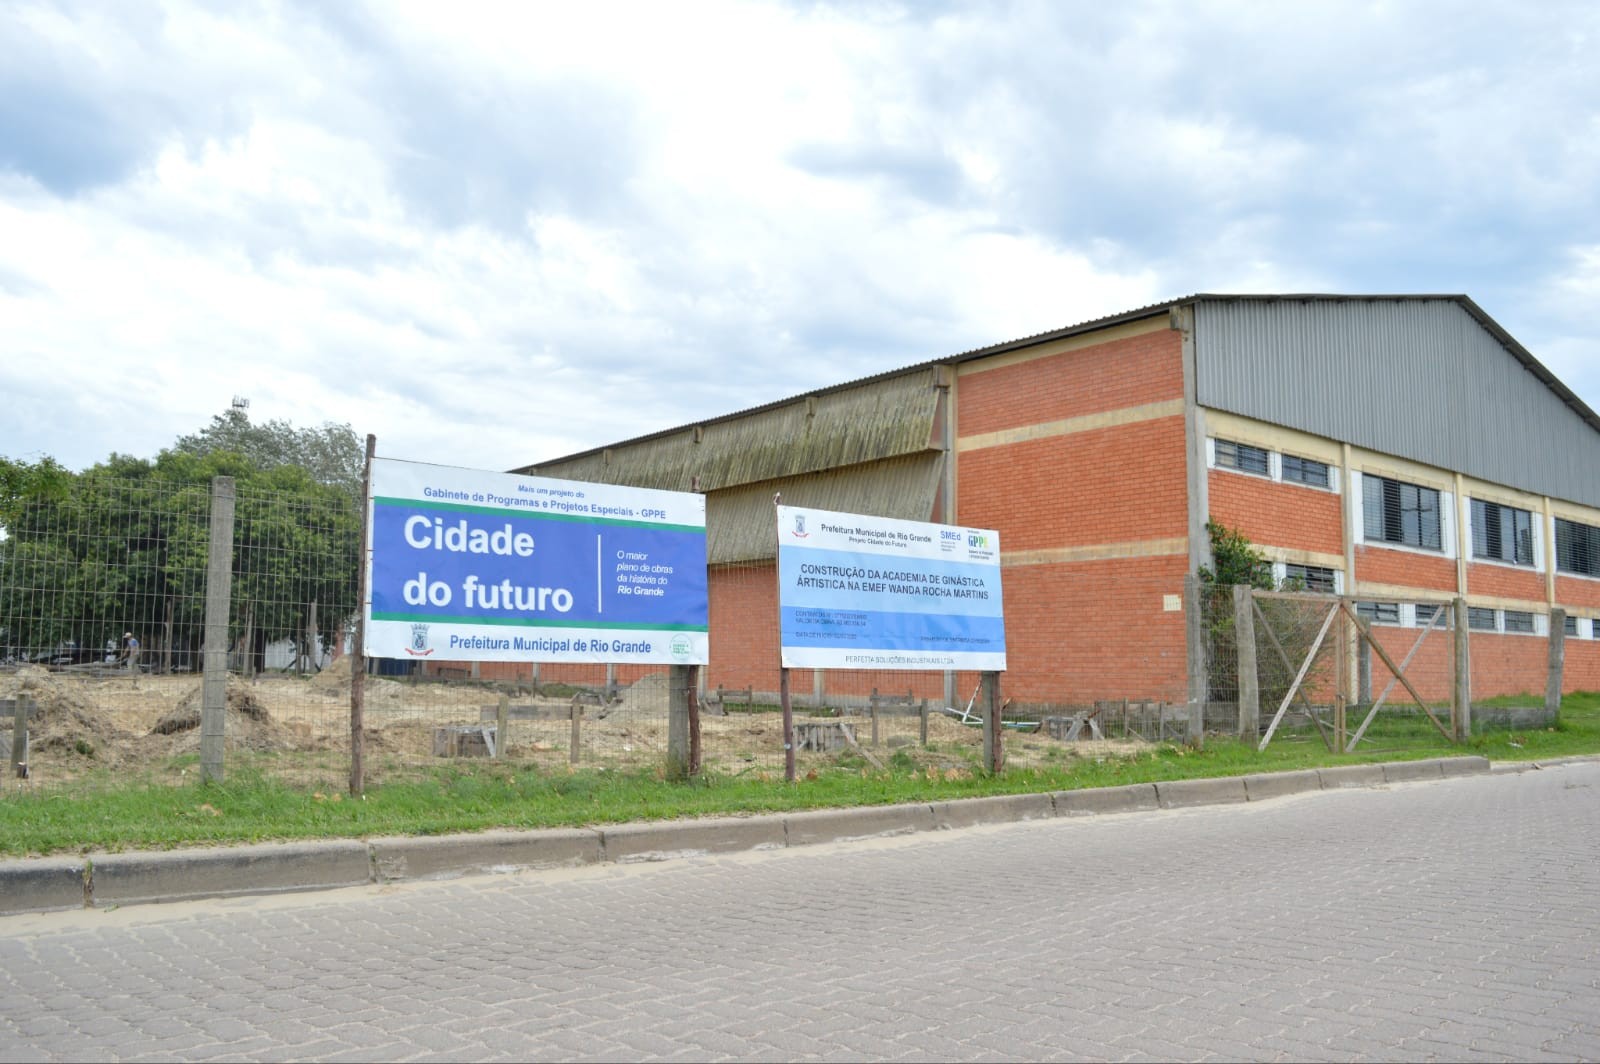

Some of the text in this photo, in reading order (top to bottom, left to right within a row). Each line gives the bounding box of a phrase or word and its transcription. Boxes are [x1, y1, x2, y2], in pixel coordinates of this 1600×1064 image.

[518, 484, 534, 493] Mais
[549, 489, 574, 498] projeto
[424, 487, 469, 501] Gabinete
[472, 493, 484, 502] de
[487, 494, 540, 507] Programas
[550, 500, 588, 512] Projetos
[592, 504, 634, 516] Especiais
[642, 508, 666, 519] GPPE
[404, 514, 534, 556] Cidade
[821, 524, 854, 535] Prefeitura
[856, 528, 887, 538] Municipal
[898, 532, 908, 541] Rio
[910, 534, 932, 543] Grande
[617, 550, 648, 560] O maior
[616, 562, 673, 574] plano de obras
[800, 564, 985, 588] CONSTRUÇÃO DA ACADEMIA DE GINÁSTICA
[617, 574, 668, 585] da história do
[796, 574, 989, 600] ÁRTISTICA NA EMEF WANDA ROCHA MARTINS
[403, 572, 574, 612] do futuro
[617, 584, 664, 596] Rio Grande
[450, 634, 652, 654] Prefeitura Municipal de Rio Grande
